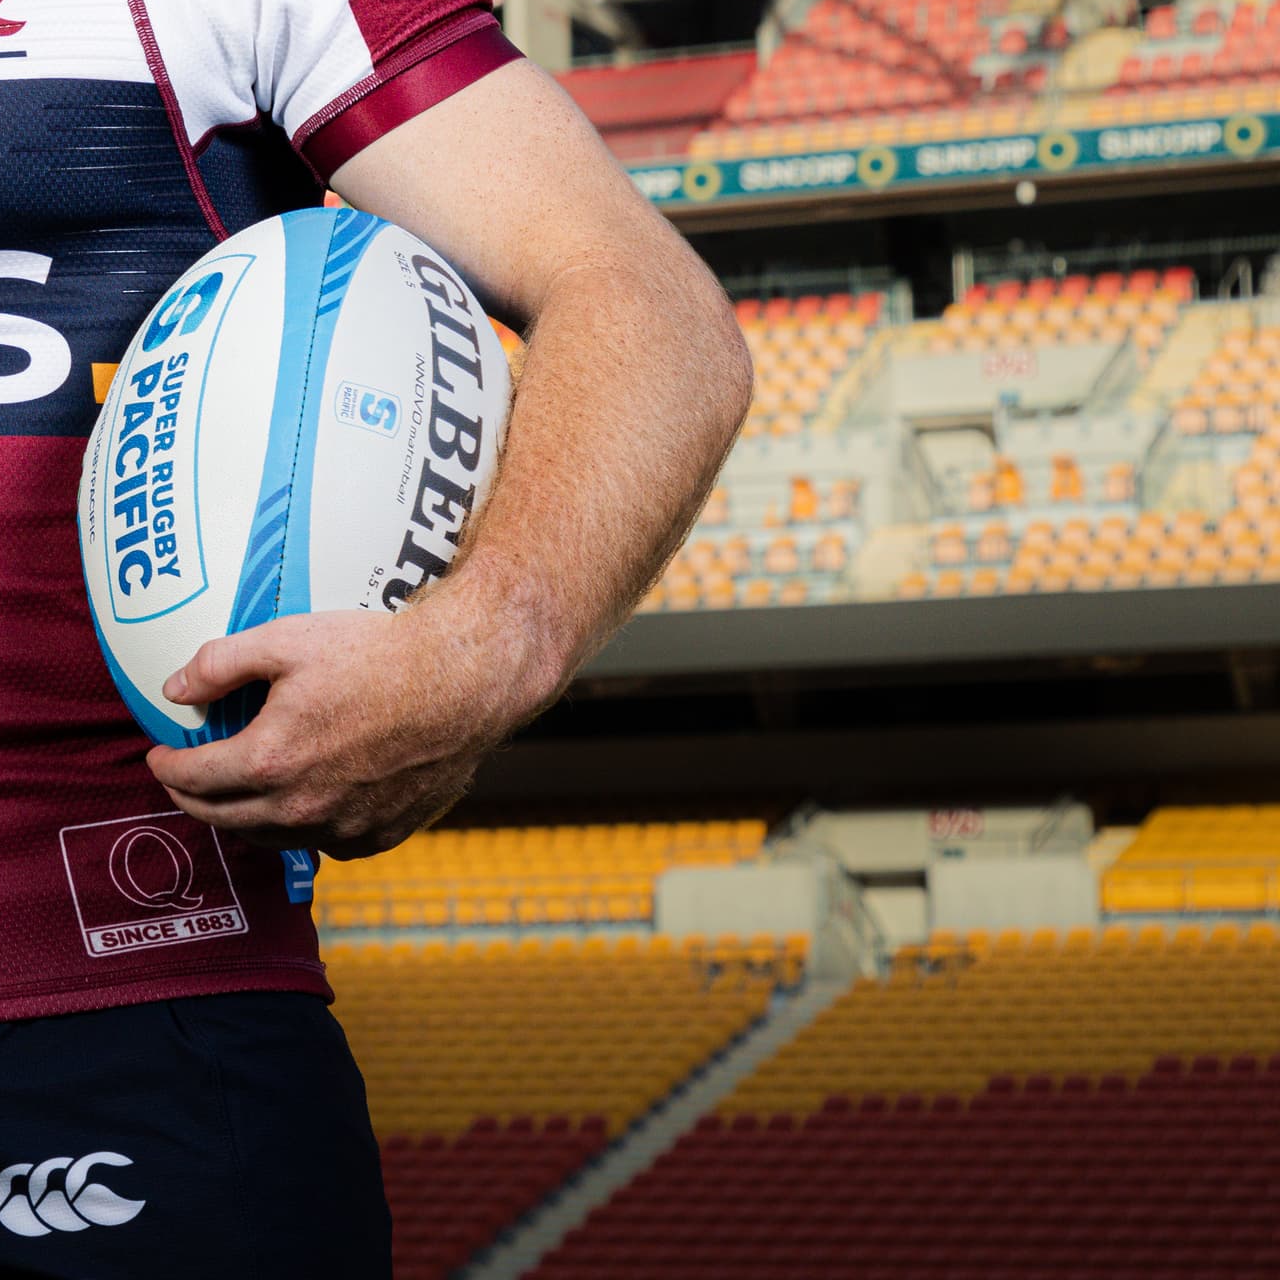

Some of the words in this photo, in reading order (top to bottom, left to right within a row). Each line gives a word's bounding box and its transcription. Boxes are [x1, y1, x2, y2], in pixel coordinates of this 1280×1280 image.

[159, 351, 189, 455] SUPER
[113, 360, 165, 597] PACIFIC
[151, 460, 182, 579] RUGBY
[109, 825, 204, 911] Q
[100, 922, 179, 949] SINCE
[183, 912, 236, 936] 1883
